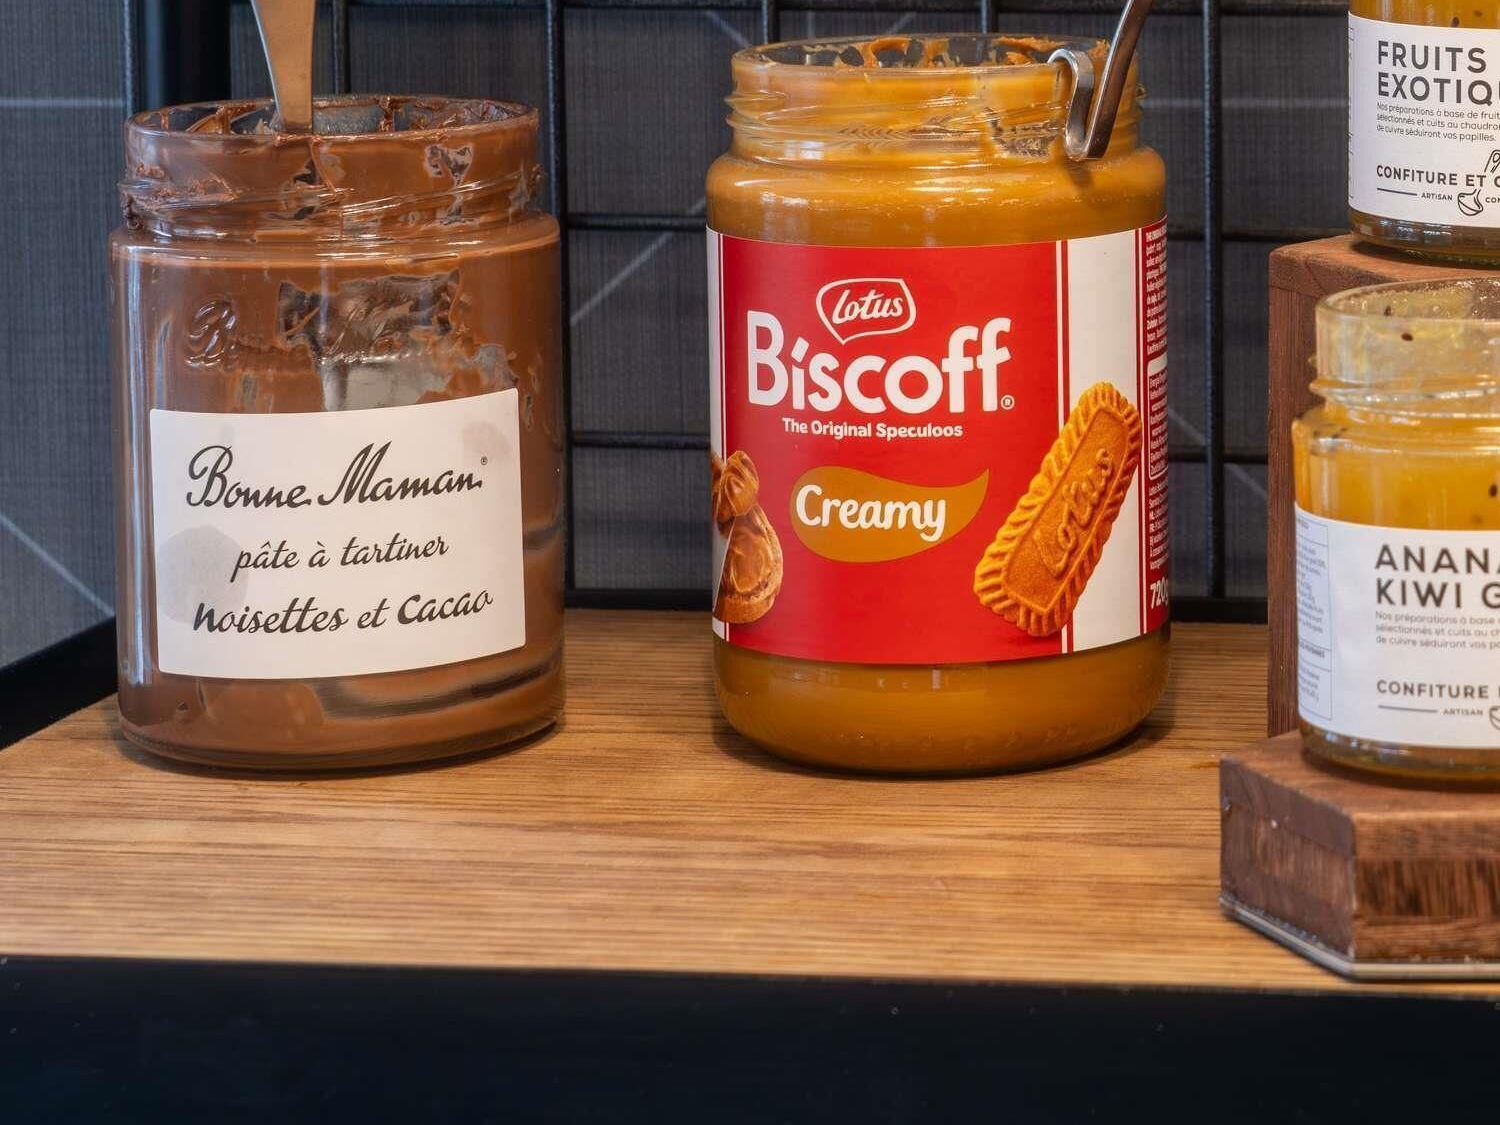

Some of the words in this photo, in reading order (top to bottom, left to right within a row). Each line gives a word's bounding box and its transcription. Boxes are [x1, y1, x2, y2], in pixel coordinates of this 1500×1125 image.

[1378, 40, 1487, 74] FRUITS
[1376, 164, 1458, 186] CONFITURE
[1465, 174, 1486, 187] ET
[1421, 191, 1453, 202] ARTISAN
[832, 289, 904, 325] Lotus
[747, 310, 1012, 414] Biscoff
[782, 418, 808, 434] The
[811, 419, 872, 440] Original
[876, 422, 963, 442] Speculoos
[185, 445, 310, 508] Bonne
[317, 441, 483, 506] Maman
[796, 484, 946, 542] Creamy
[230, 540, 300, 583] pâte
[308, 541, 330, 568] à
[340, 532, 449, 566] tartiner
[1376, 579, 1461, 608] KIWI
[357, 597, 389, 629] et
[1377, 679, 1489, 699] CONFITURE
